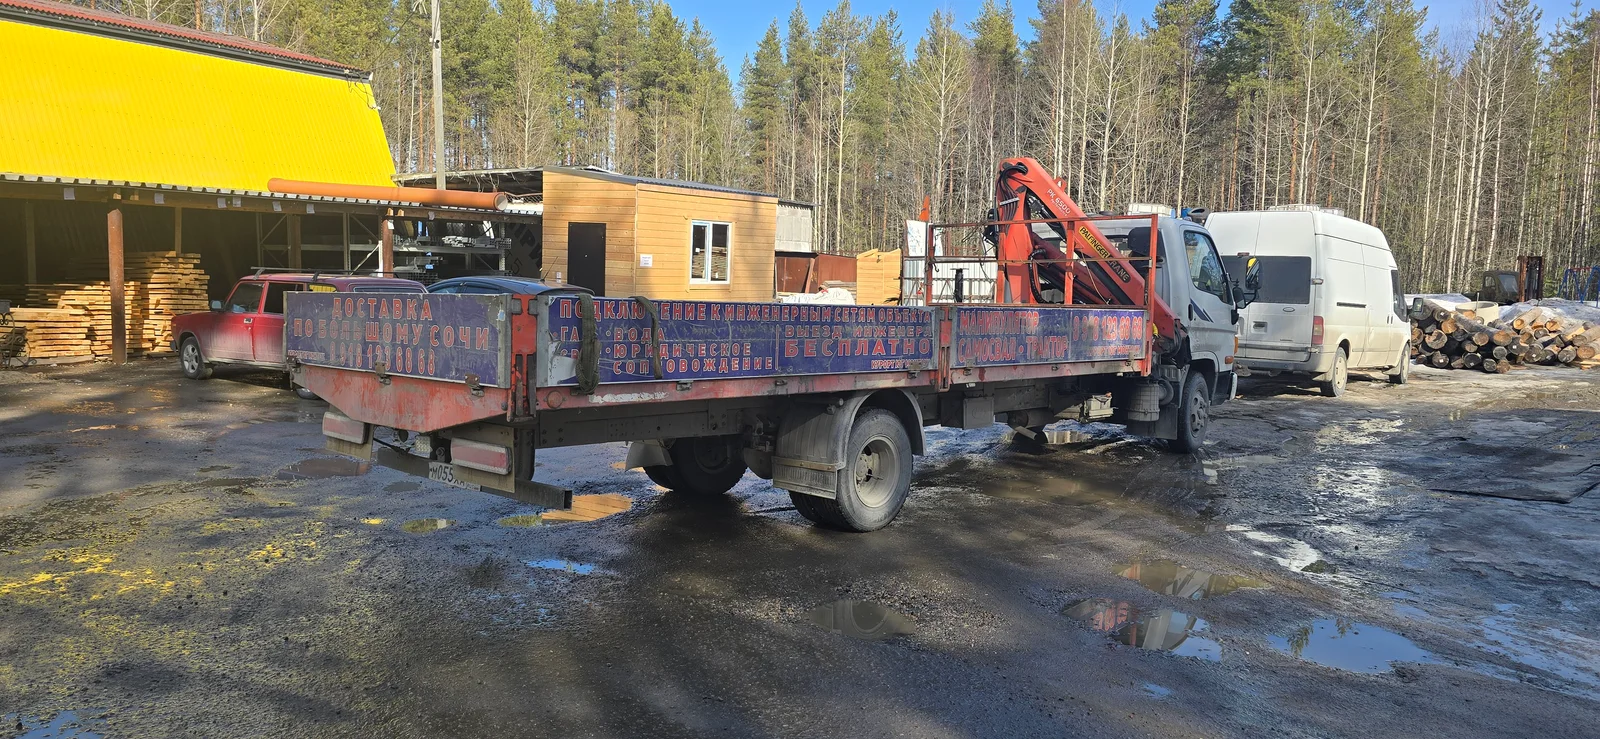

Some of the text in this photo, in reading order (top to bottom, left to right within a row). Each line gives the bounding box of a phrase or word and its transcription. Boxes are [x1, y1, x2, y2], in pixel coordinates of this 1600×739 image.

[1046, 188, 1071, 214] PK 6500
[1079, 226, 1109, 258] PALFINGER
[332, 297, 433, 321] ДОСТАВКА
[560, 299, 706, 322] ПОДКЛЮЕНИЕ
[834, 307, 876, 323] СЕТЯМ
[878, 308, 931, 323] ОБЪЕКТА
[293, 318, 490, 351] ПО БОЛЬШОМУ СОЧИ
[785, 325, 932, 340] ВЫЕЗД ИНЖЕНЕРА
[959, 310, 1040, 335] МАНИПУЛЯТОР
[613, 343, 751, 359] ЮРИДИЧЕСКОЕ
[784, 339, 931, 358] БЕСПЛАТНО
[958, 335, 1069, 363] САМОСВАЛ ТРАКТОР
[396, 346, 413, 374] 68
[418, 348, 436, 376] 68
[613, 357, 773, 374] СОПОВОЖДЕНИЕ
